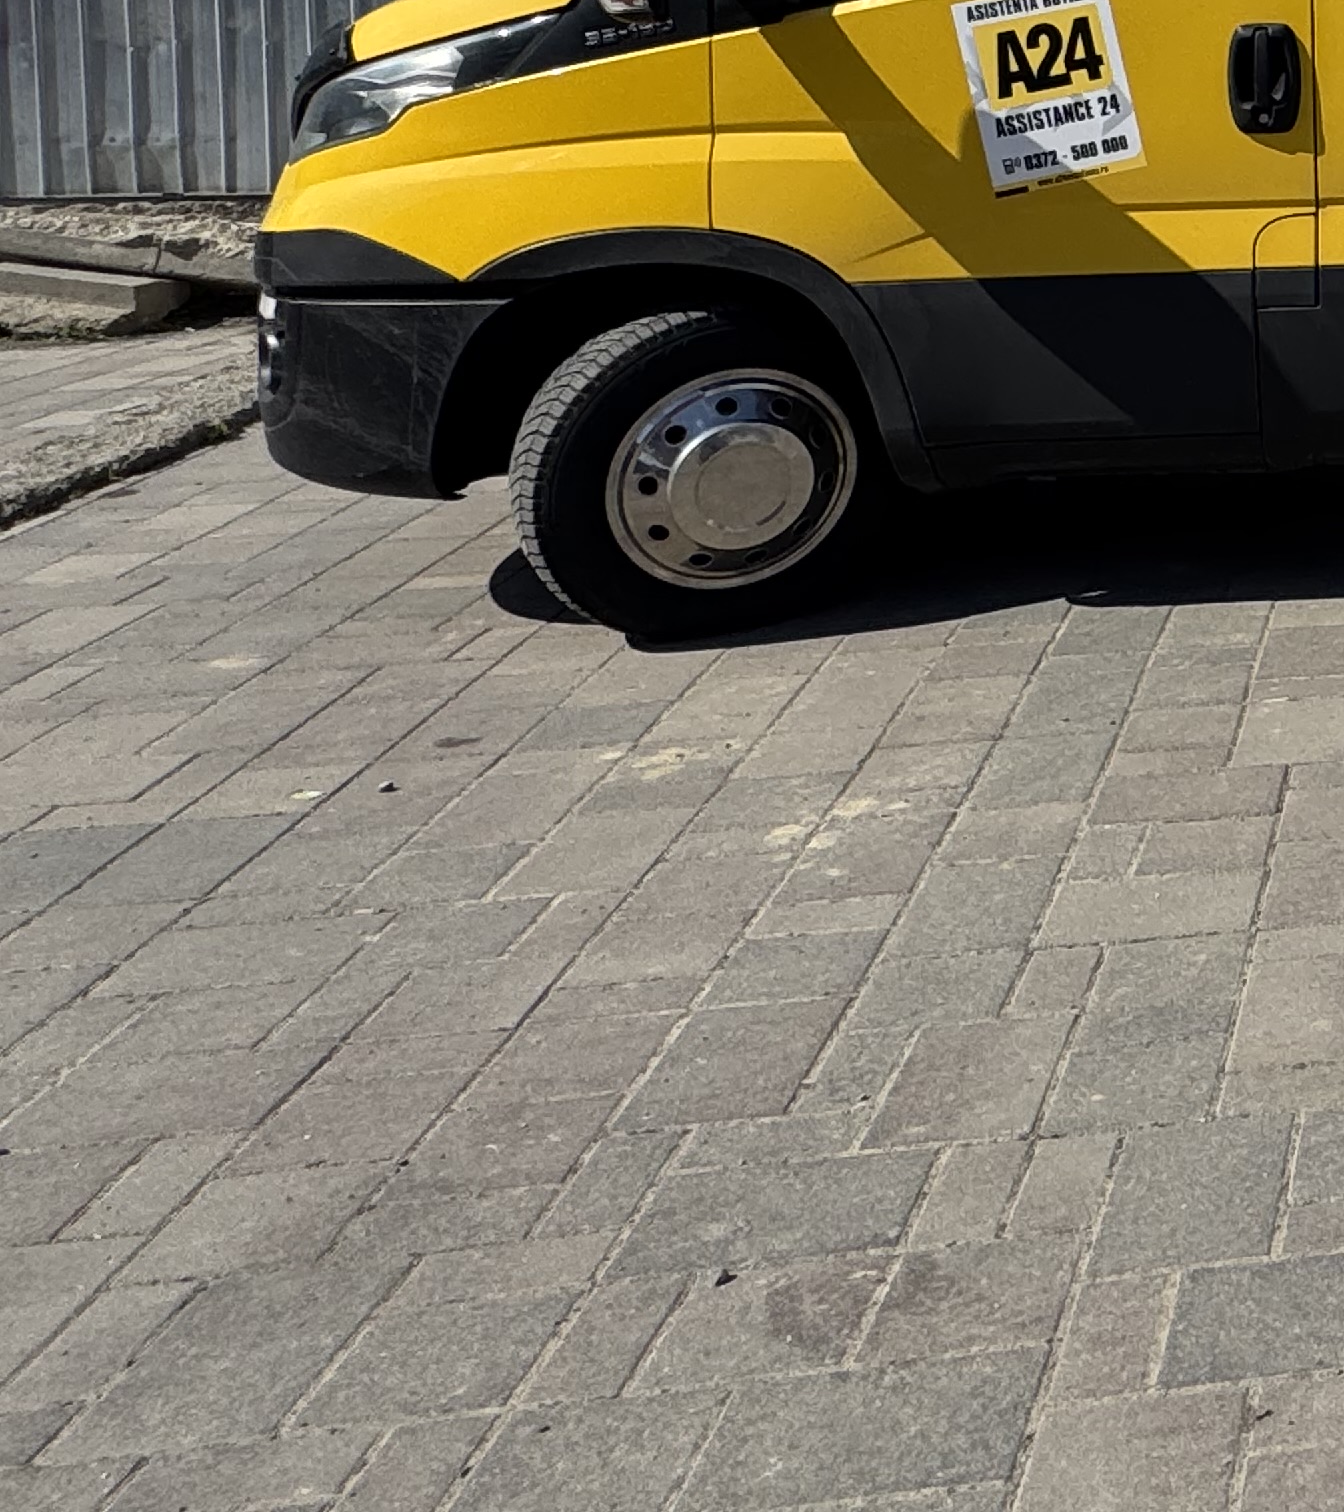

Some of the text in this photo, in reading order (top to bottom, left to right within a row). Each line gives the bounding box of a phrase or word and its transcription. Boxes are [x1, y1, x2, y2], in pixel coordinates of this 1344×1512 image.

[996, 16, 1105, 100] A24
[995, 93, 1121, 139] ASSISTANCE 24
[1024, 150, 1060, 171] 0372
